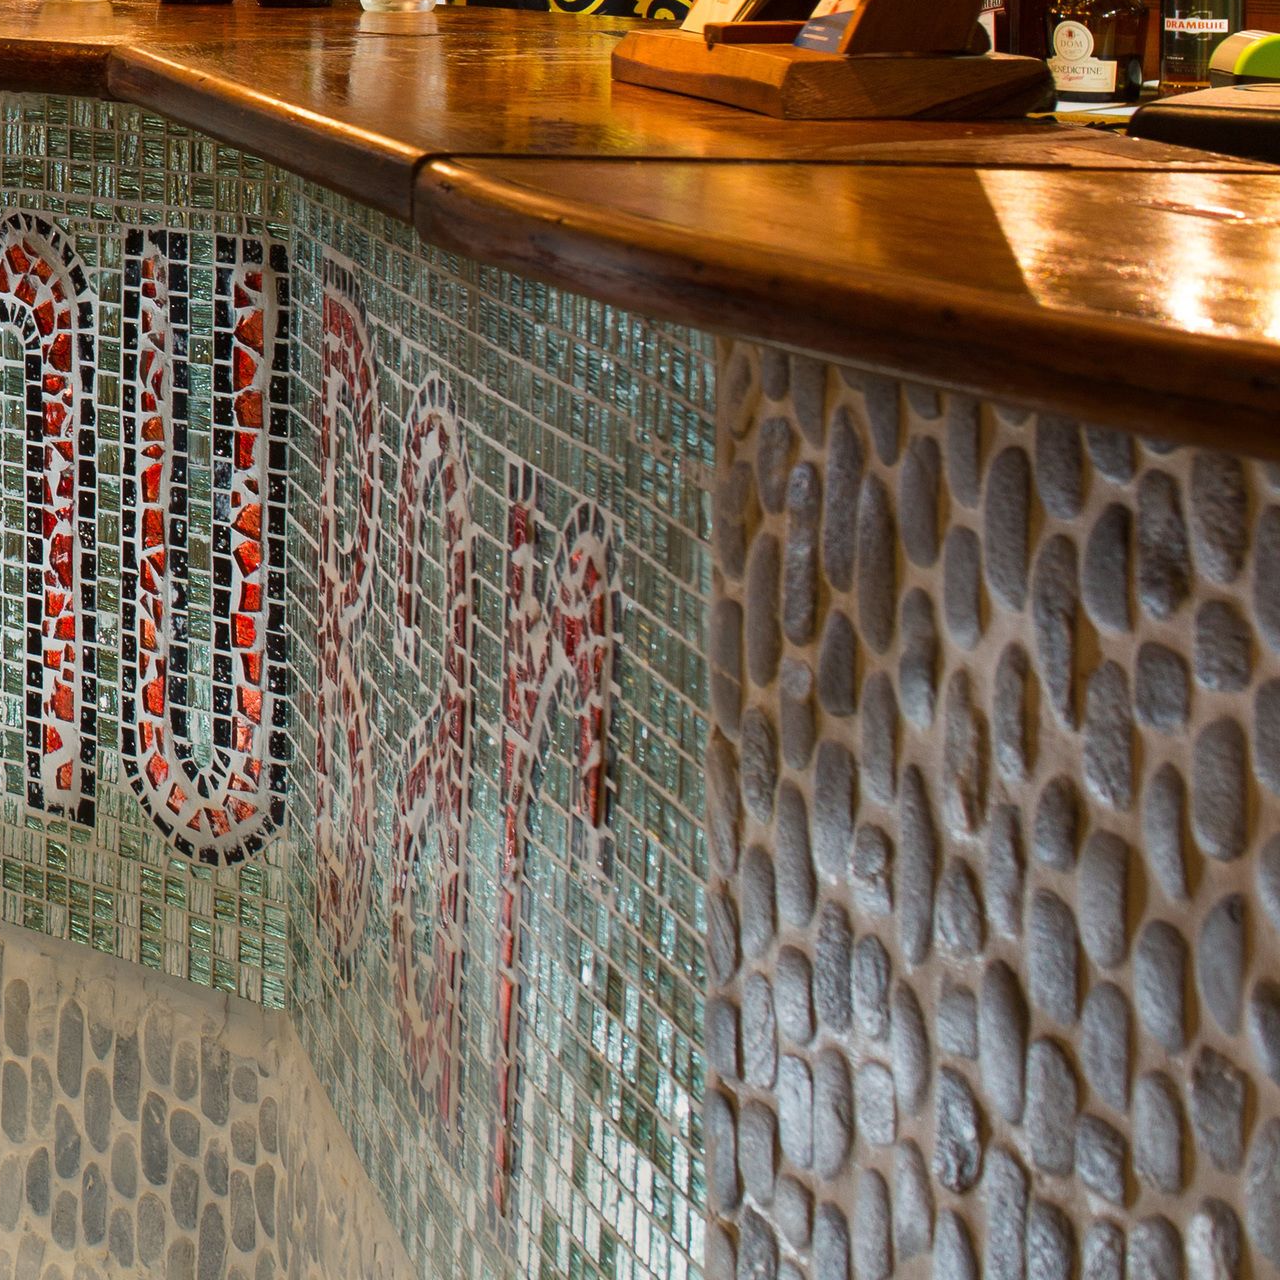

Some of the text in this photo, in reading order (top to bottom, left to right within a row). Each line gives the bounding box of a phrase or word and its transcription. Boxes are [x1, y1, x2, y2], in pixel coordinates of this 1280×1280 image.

[1166, 19, 1226, 31] DRAMBUIE
[1060, 40, 1083, 48] DOM
[316, 255, 624, 1245] Bar
